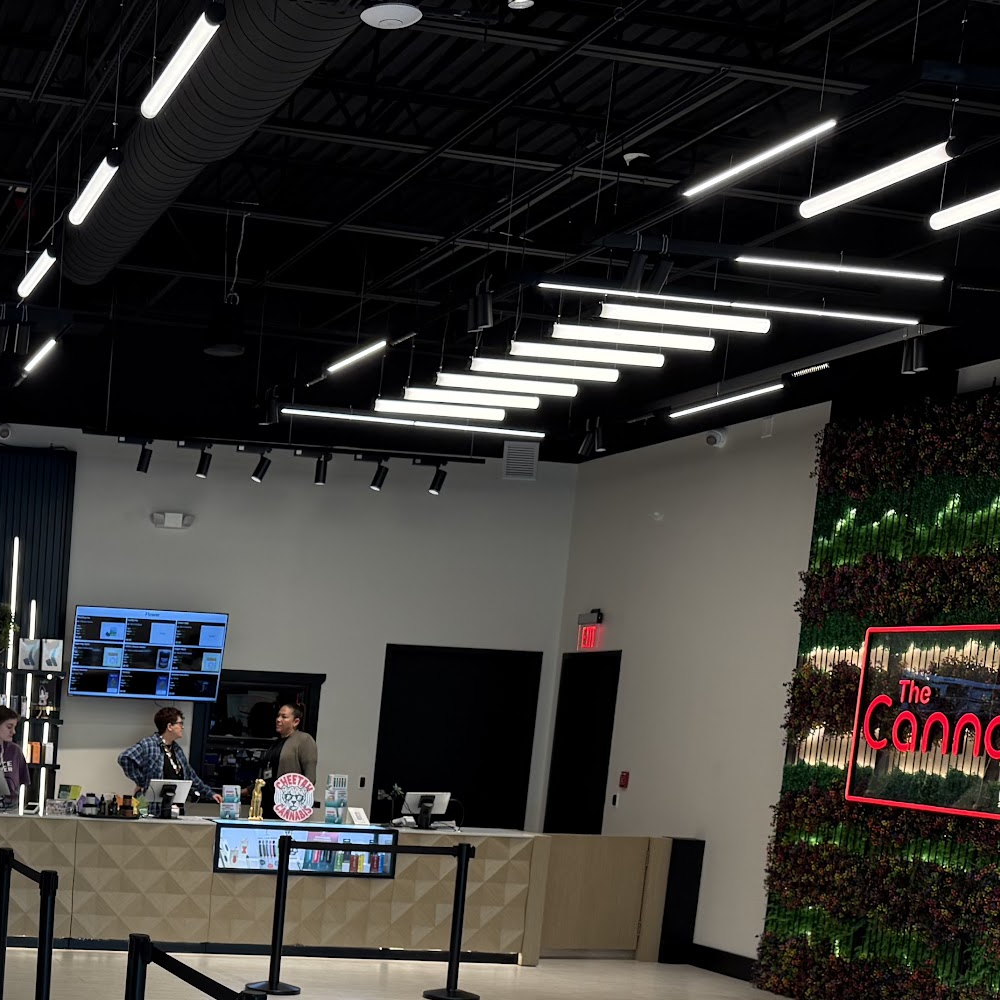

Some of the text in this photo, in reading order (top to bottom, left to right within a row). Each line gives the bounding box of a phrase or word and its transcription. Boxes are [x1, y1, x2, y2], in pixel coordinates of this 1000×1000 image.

[581, 626, 596, 648] EXIT
[899, 680, 932, 704] The
[275, 774, 313, 792] CHEETAH
[275, 804, 312, 821] CANNABIS
